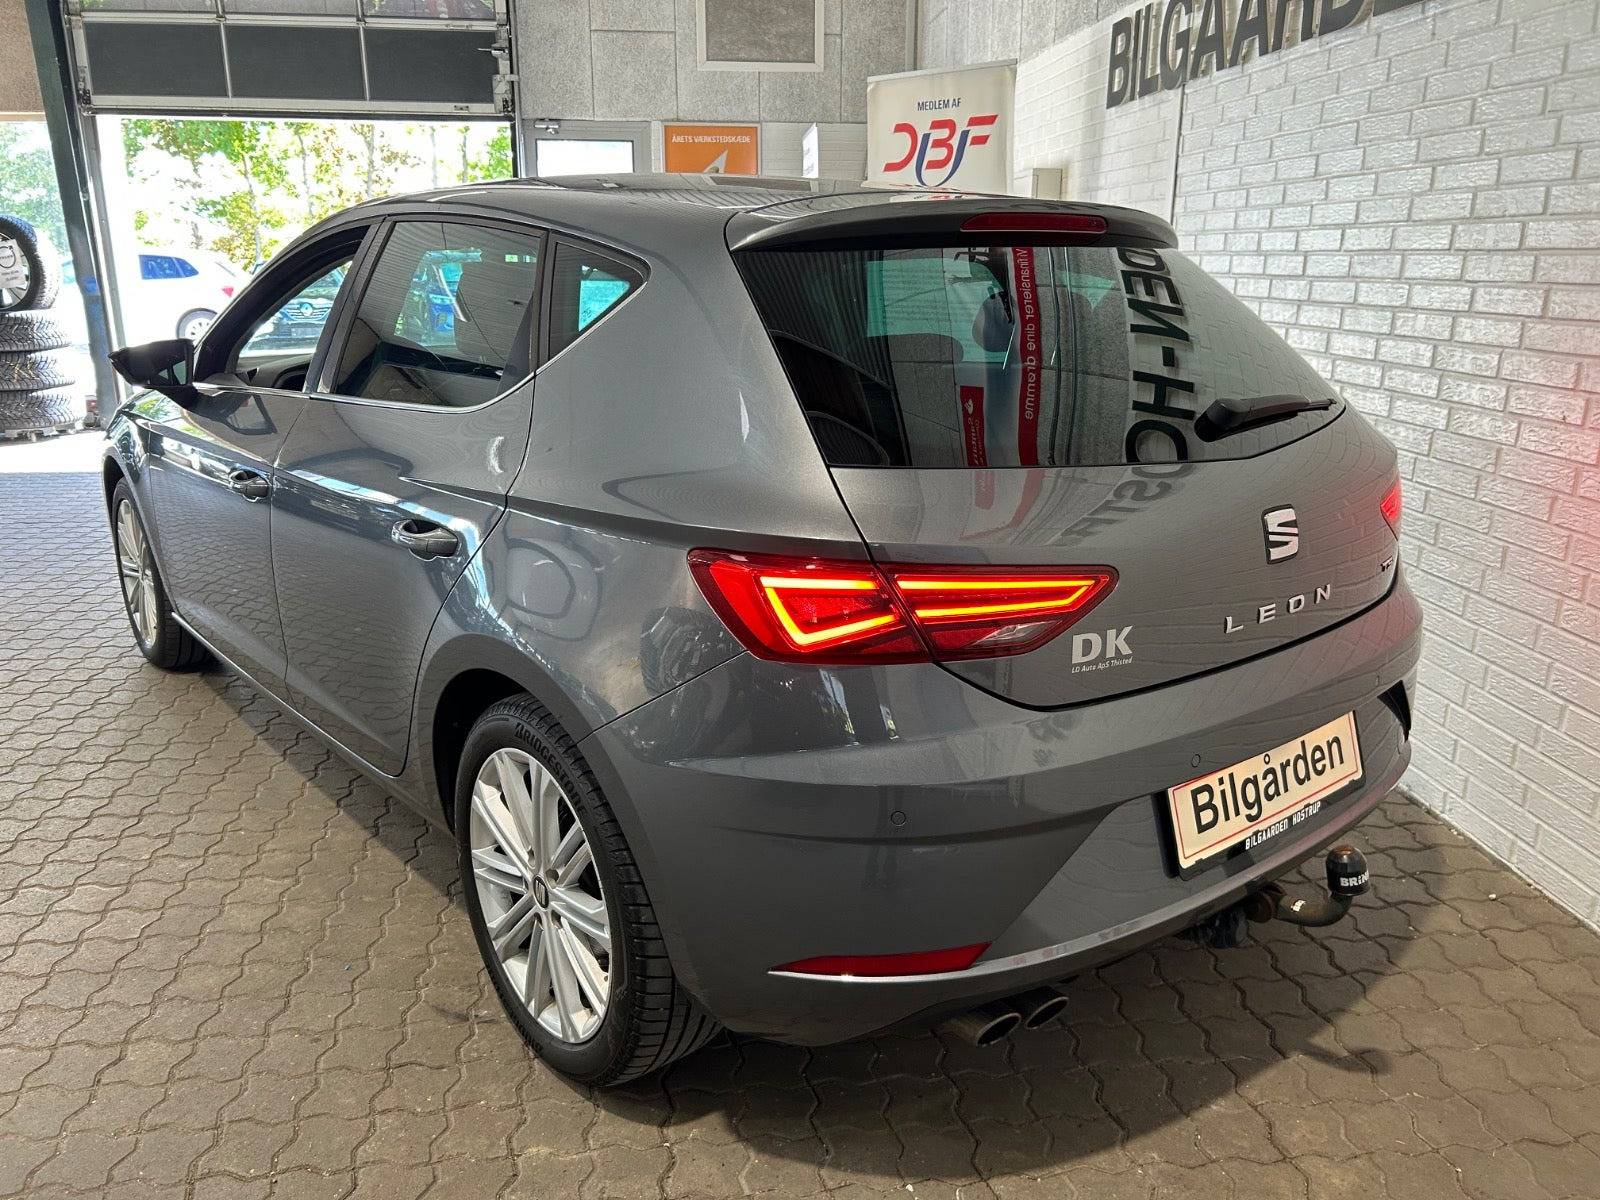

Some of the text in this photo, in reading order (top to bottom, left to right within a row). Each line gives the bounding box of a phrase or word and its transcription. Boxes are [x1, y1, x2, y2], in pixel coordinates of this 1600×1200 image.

[1106, 0, 1426, 109] BILGAA
[917, 98, 962, 111] MEDLEM AF
[672, 133, 751, 143] ÅRETS VÆRKSTEDSKÆDE
[1224, 583, 1331, 634] LEON
[1071, 625, 1134, 665] DK
[1081, 664, 1097, 672] Auto
[1097, 660, 1110, 670] ApS
[1110, 655, 1134, 667] Thisted
[514, 722, 588, 815] BRIDGESTONE
[1190, 735, 1345, 835] Bilgården
[1245, 800, 1321, 850] BILGAARDEN HOSTRUP
